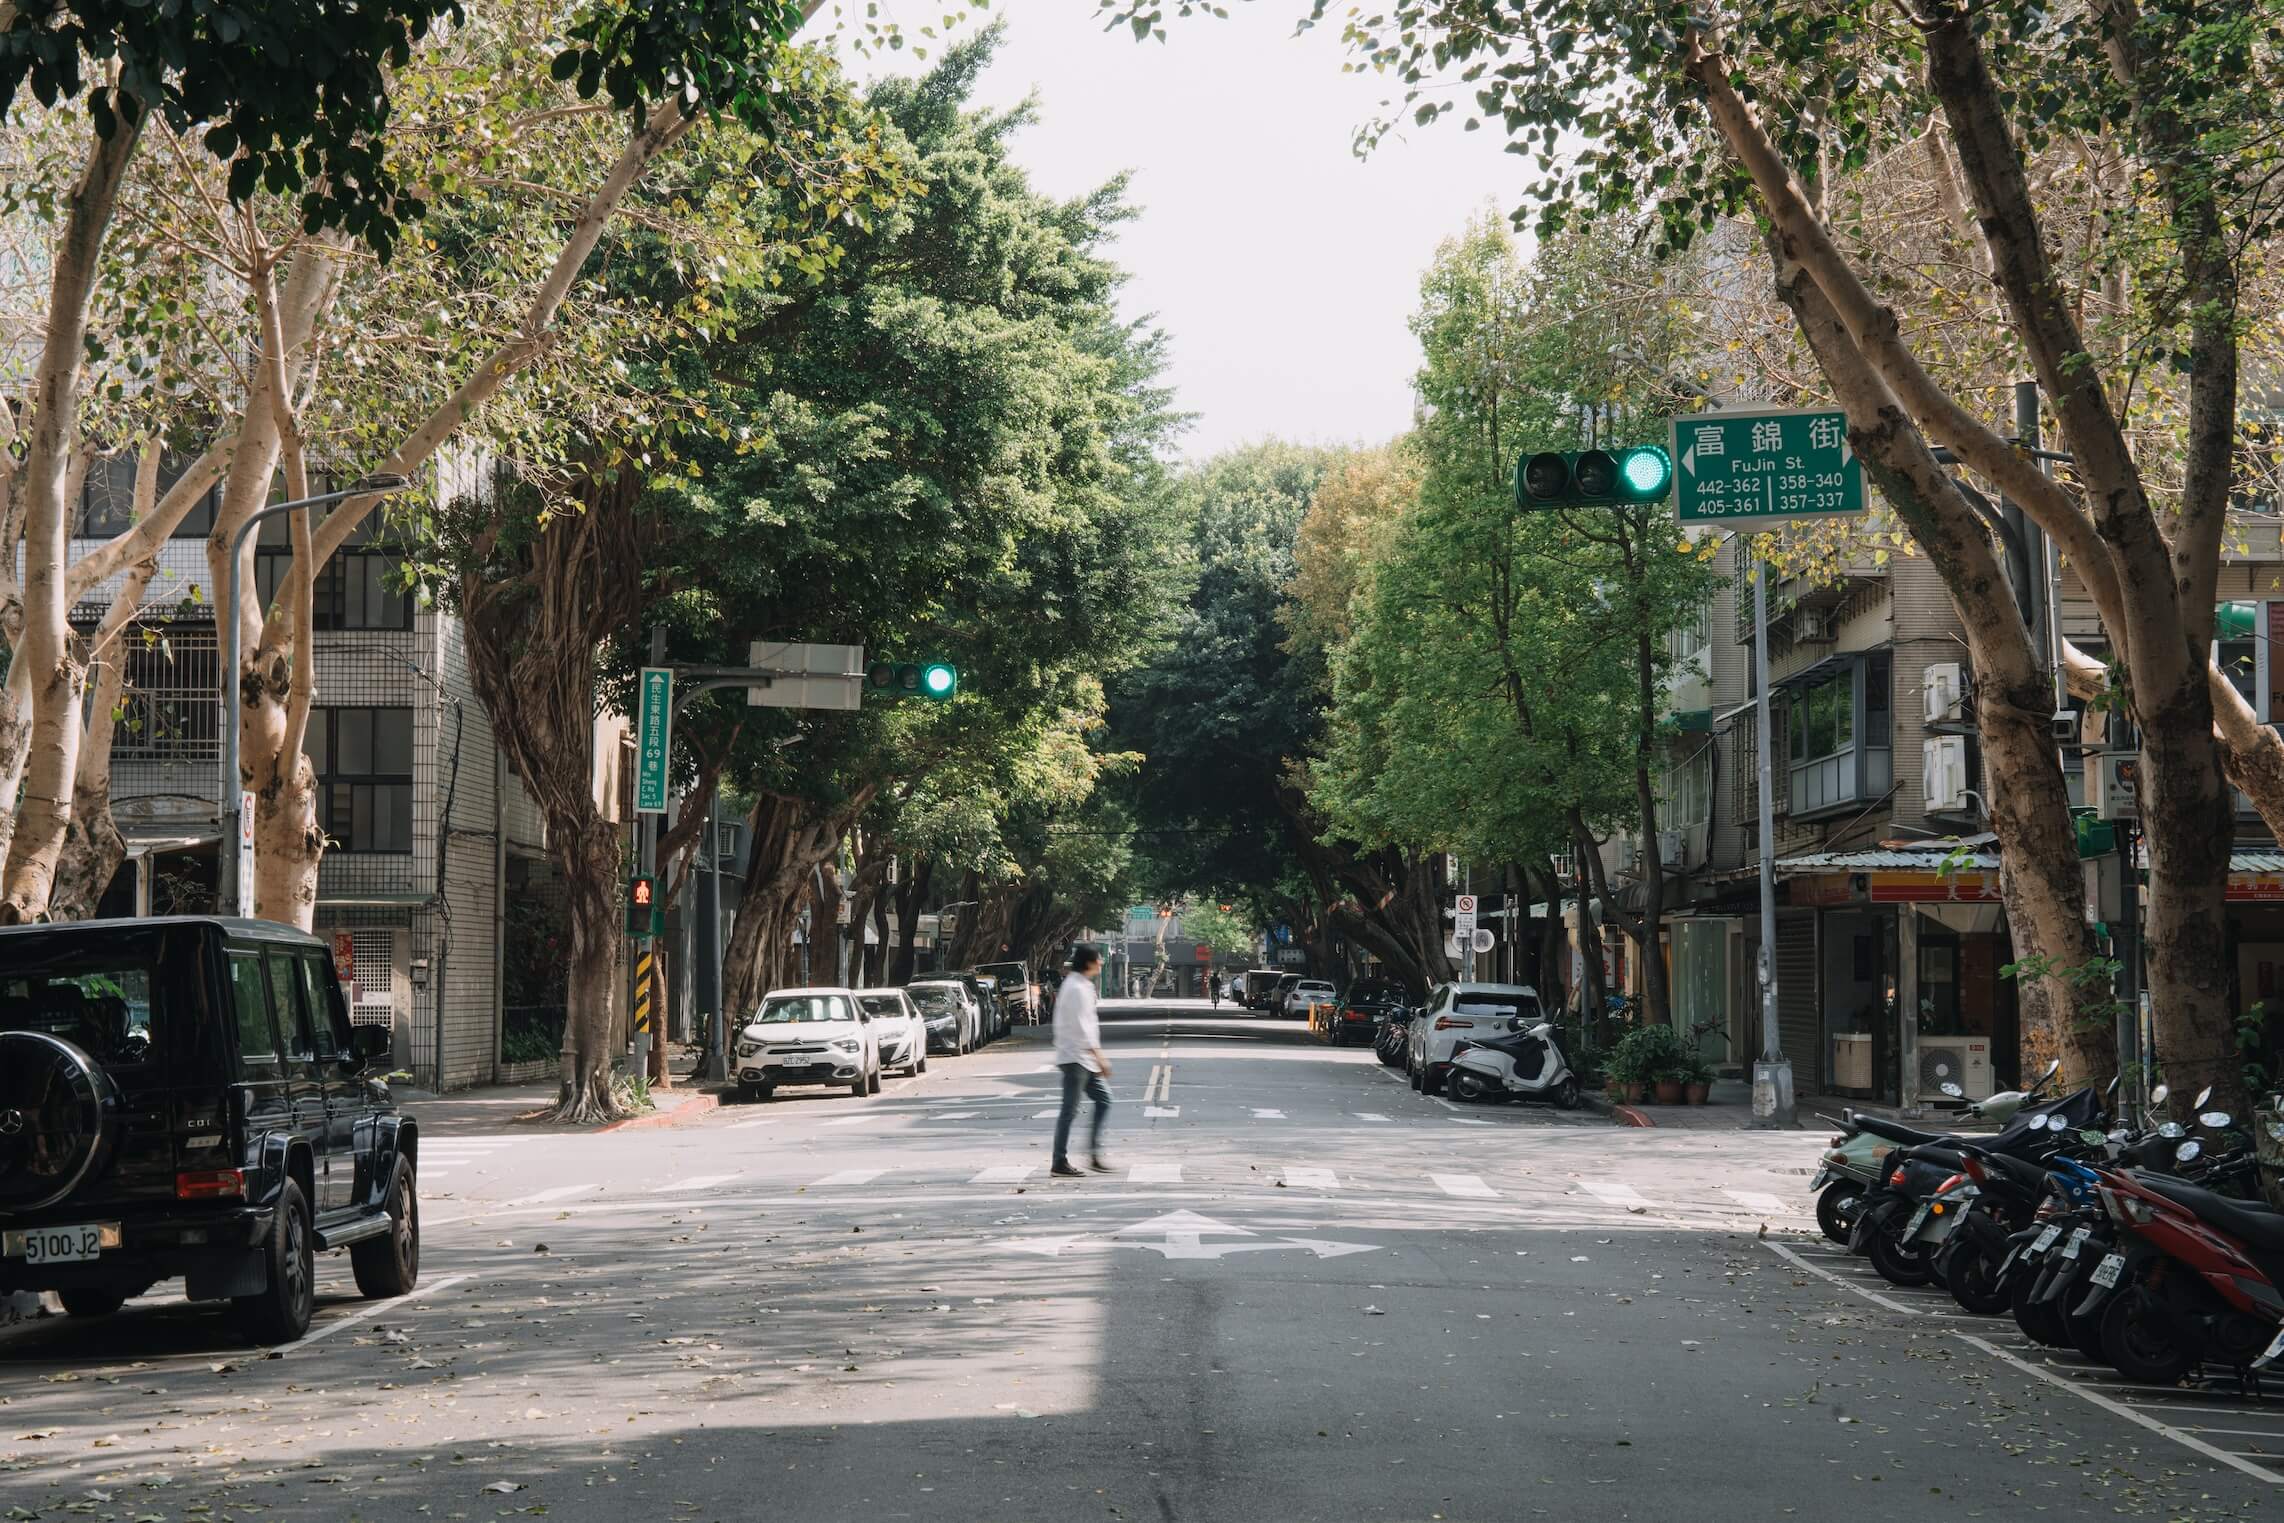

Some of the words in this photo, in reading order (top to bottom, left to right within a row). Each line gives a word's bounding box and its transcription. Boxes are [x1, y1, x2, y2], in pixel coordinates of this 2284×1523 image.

[1694, 418, 1840, 456] 富錦街
[1785, 456, 1806, 470] St.
[1697, 478, 1761, 495] 442-362
[1779, 472, 1843, 490] 358-340
[1697, 498, 1761, 515] 405-361
[1780, 492, 1844, 510] 357-337
